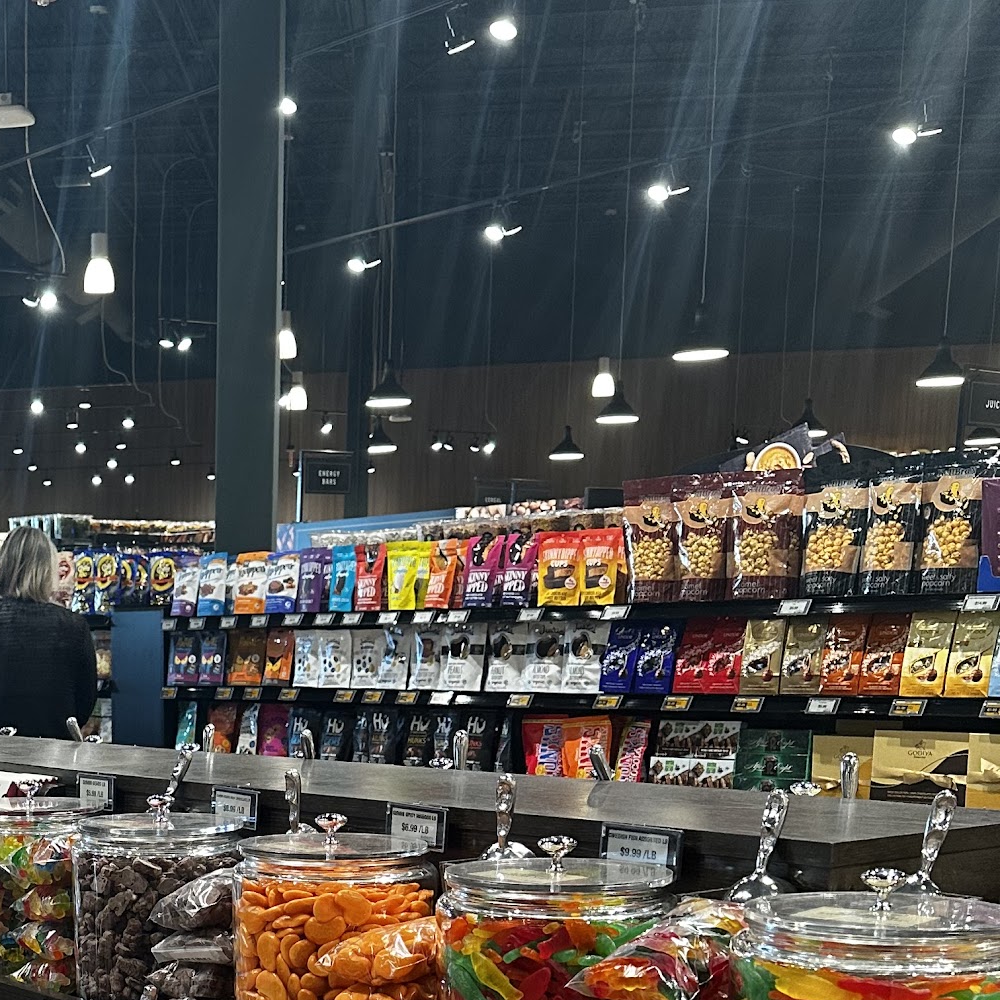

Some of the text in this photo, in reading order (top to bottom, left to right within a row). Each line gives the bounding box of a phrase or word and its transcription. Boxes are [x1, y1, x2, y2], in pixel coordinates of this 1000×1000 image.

[318, 469, 341, 477] ENERGY
[321, 478, 337, 486] BARS
[550, 558, 569, 568] CUPS
[620, 846, 657, 860] $9.99 /LB
